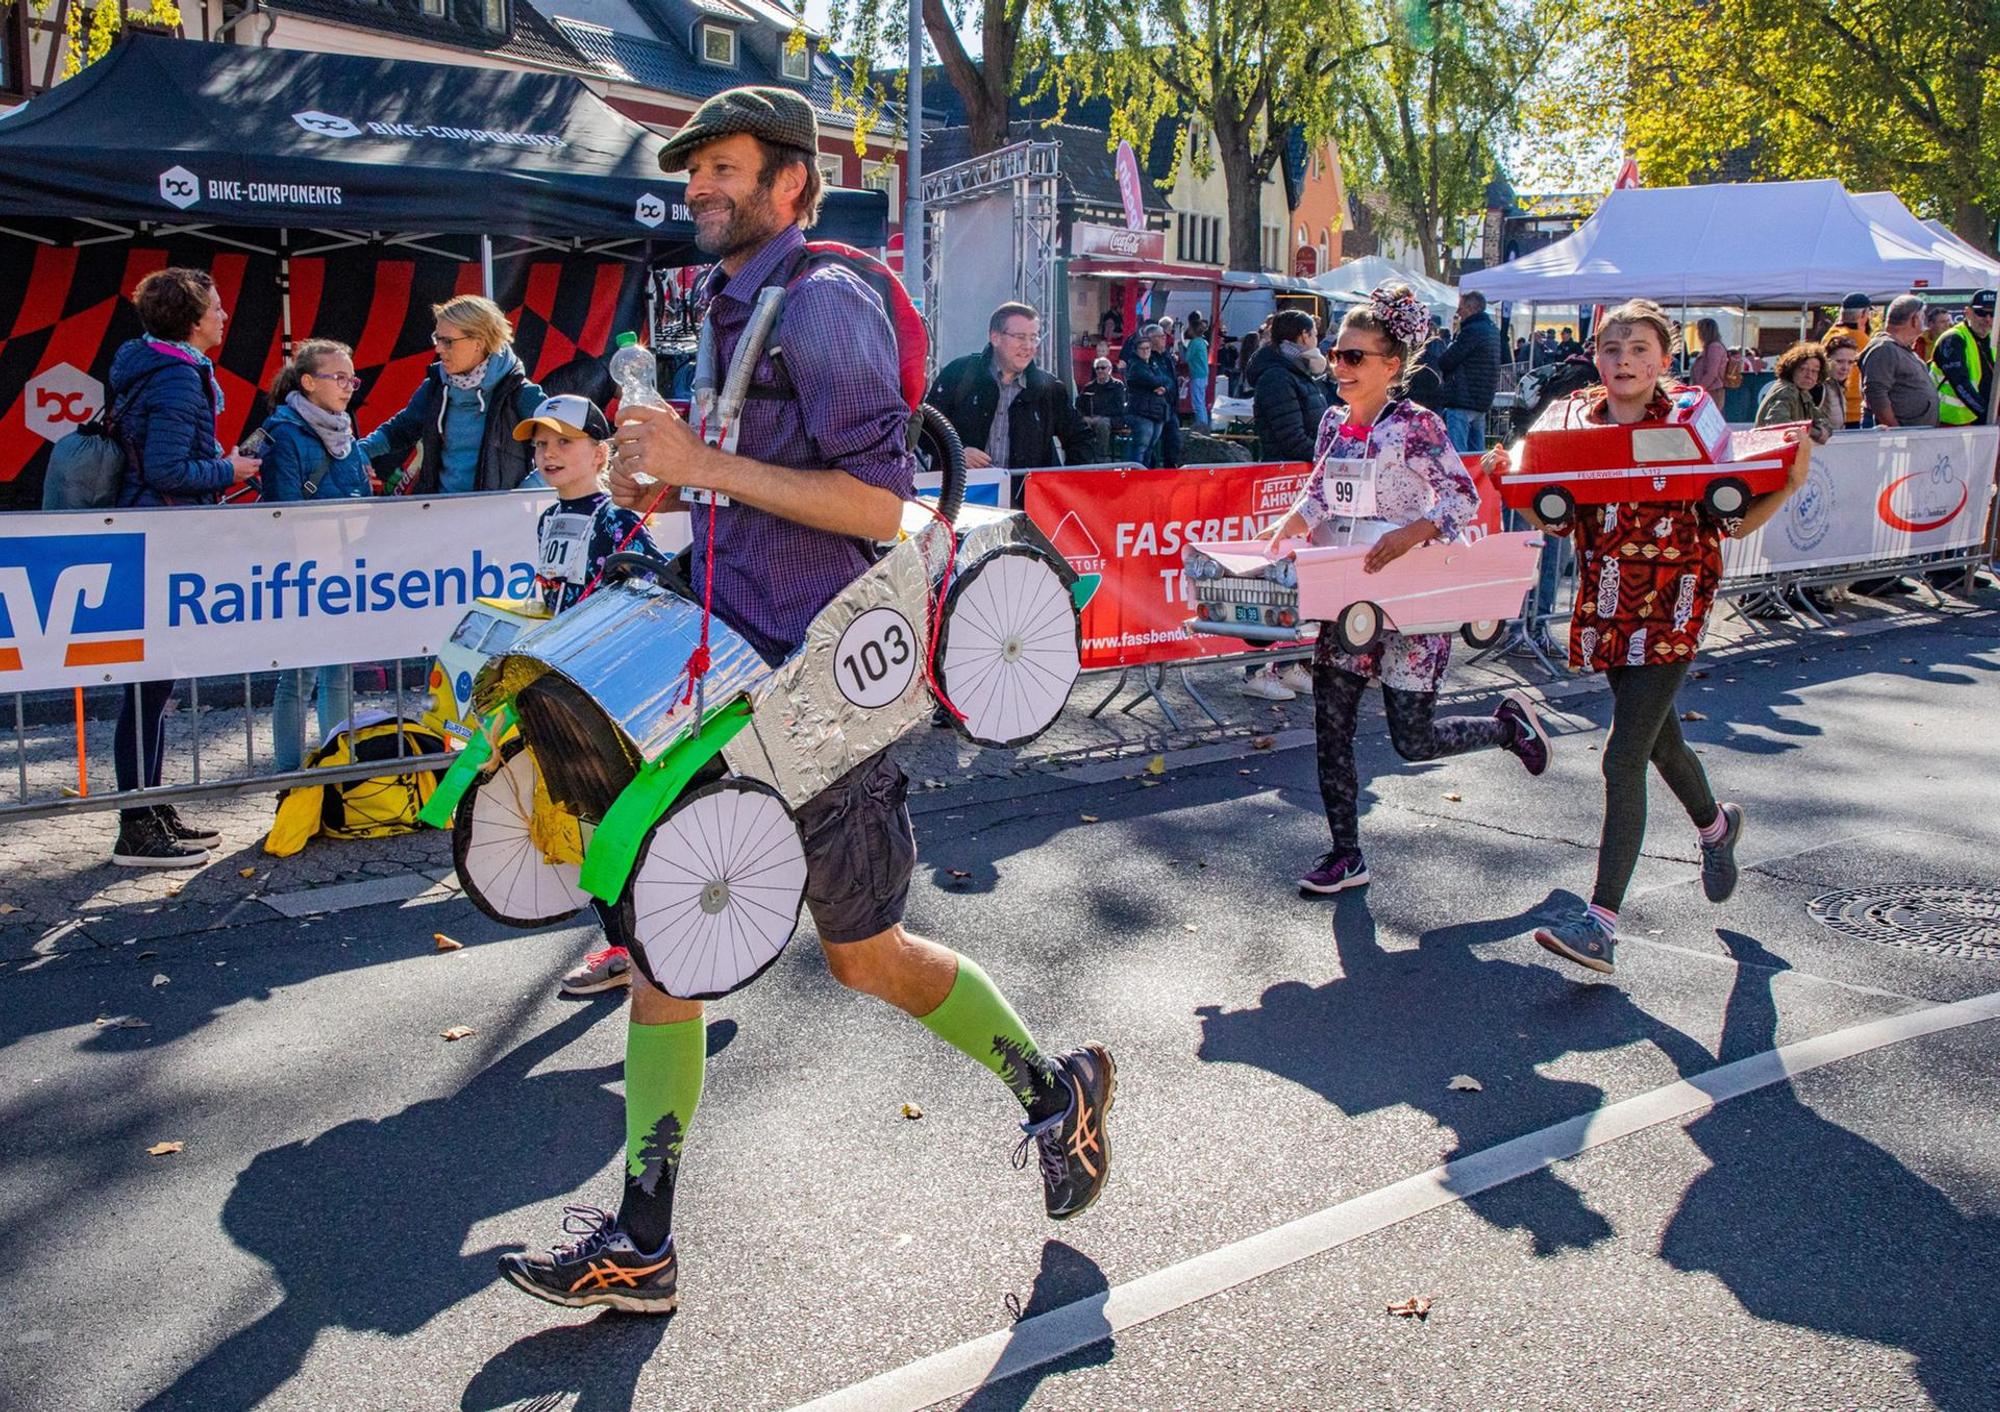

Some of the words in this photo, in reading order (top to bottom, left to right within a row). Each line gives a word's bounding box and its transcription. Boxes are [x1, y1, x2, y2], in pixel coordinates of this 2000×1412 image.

[367, 121, 567, 148] BIKE-COMPONENTS
[208, 180, 342, 205] BIKE-COMPONENTS
[671, 203, 695, 221] BIK
[1577, 470, 1624, 479] FEUERWEHR
[1649, 468, 1662, 476] 112
[1260, 479, 1294, 494] JETZT
[1335, 481, 1354, 504] 99
[168, 549, 536, 627] Raiffeisenba
[843, 624, 910, 692] 103
